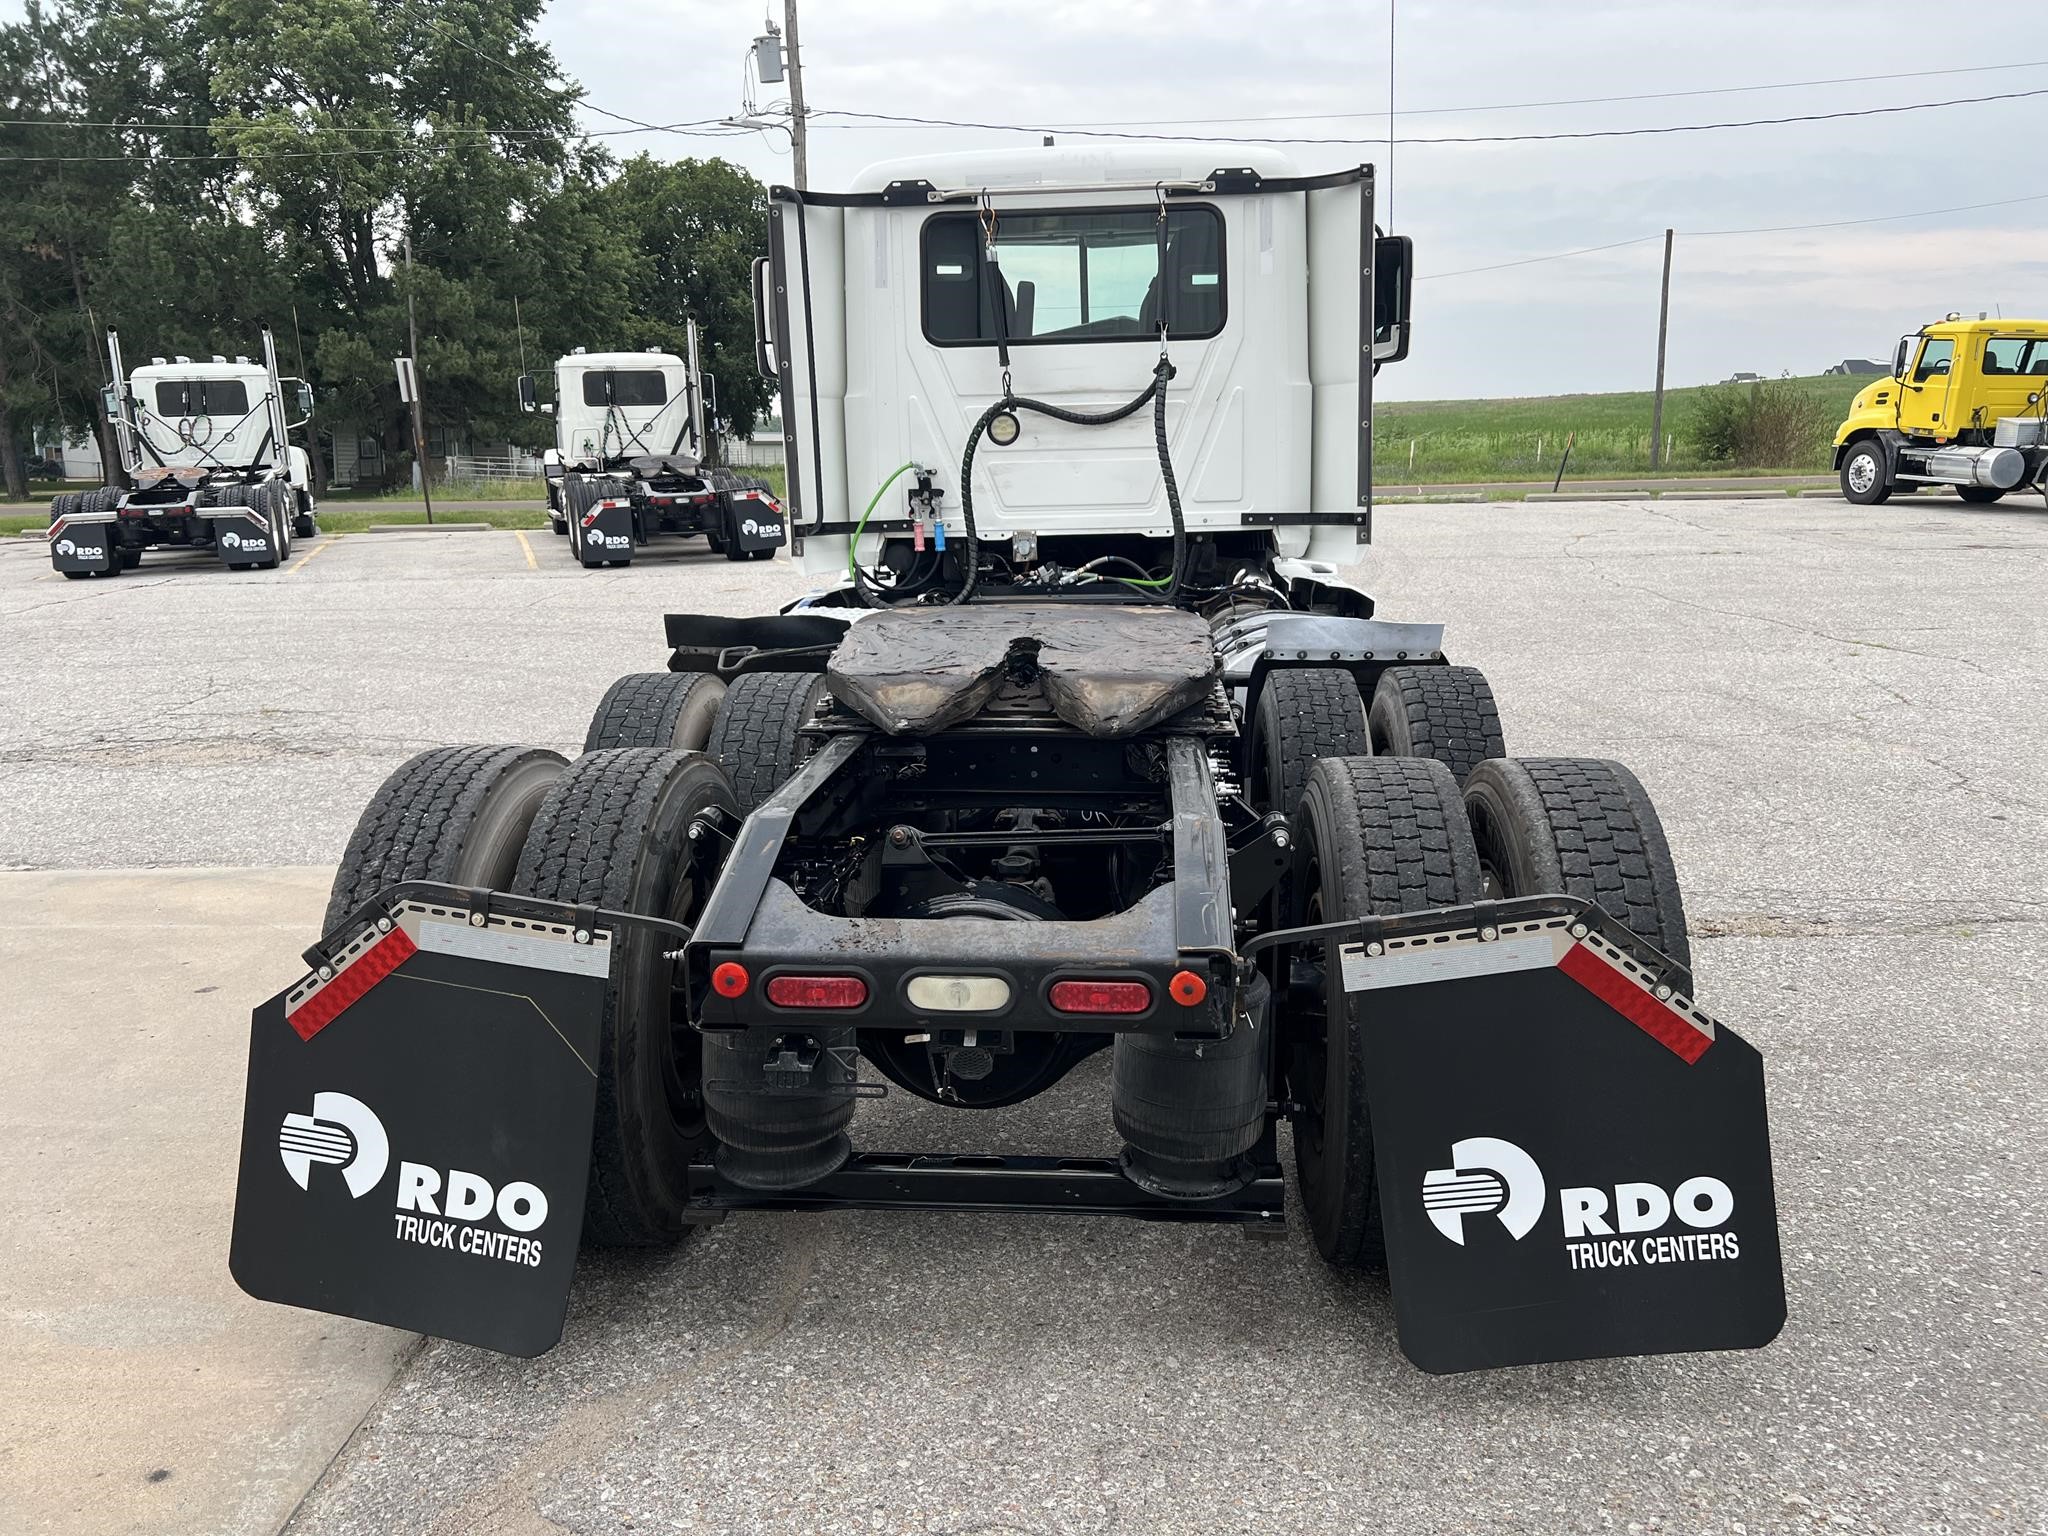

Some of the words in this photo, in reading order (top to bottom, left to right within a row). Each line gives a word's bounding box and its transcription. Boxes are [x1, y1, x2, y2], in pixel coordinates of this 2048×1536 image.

[605, 535, 629, 544] RDO
[758, 524, 781, 533] RDO
[76, 547, 103, 556] RDO
[241, 538, 266, 547] RDO
[396, 1160, 549, 1232] RDO
[1559, 1176, 1734, 1238] RDO
[394, 1213, 457, 1250] TRUCK
[459, 1226, 543, 1268] CENTERS
[1565, 1239, 1639, 1270] TRUCK
[1641, 1231, 1740, 1265] CENTERS
